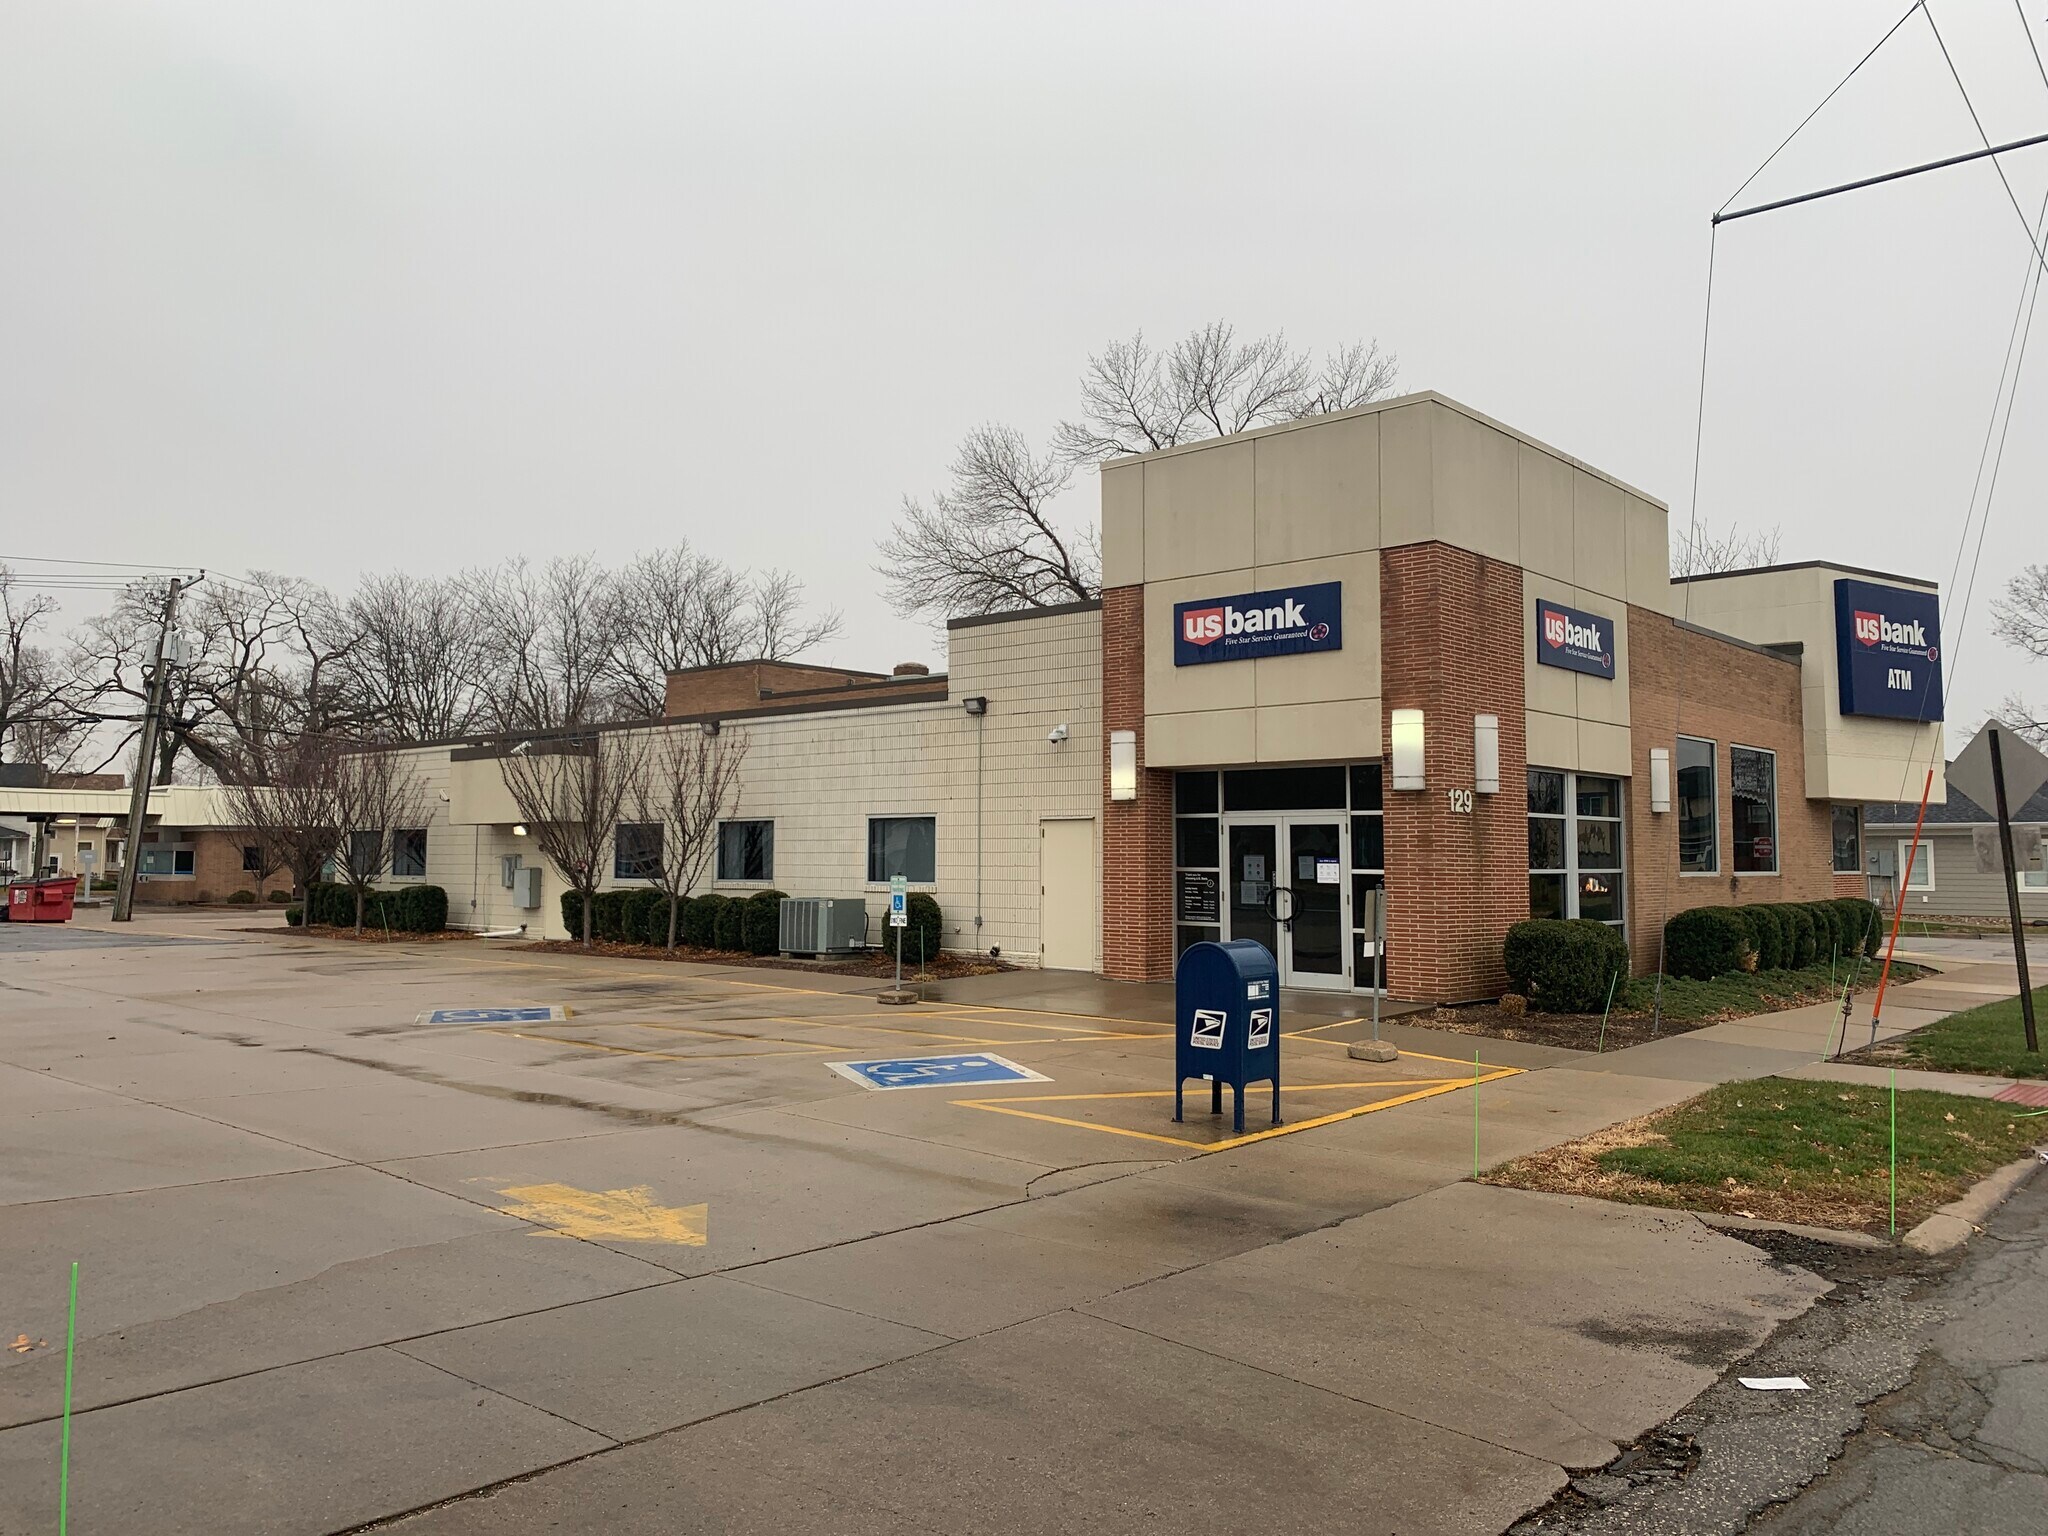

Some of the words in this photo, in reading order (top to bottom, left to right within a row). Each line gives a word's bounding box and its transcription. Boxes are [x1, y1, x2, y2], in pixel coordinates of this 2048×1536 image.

[1225, 637, 1238, 646] Five
[1238, 635, 1251, 645] Star
[1251, 633, 1273, 643] Service
[1273, 629, 1308, 641] Guaranteed
[1887, 668, 1912, 691] ATM
[1448, 789, 1472, 813] 129
